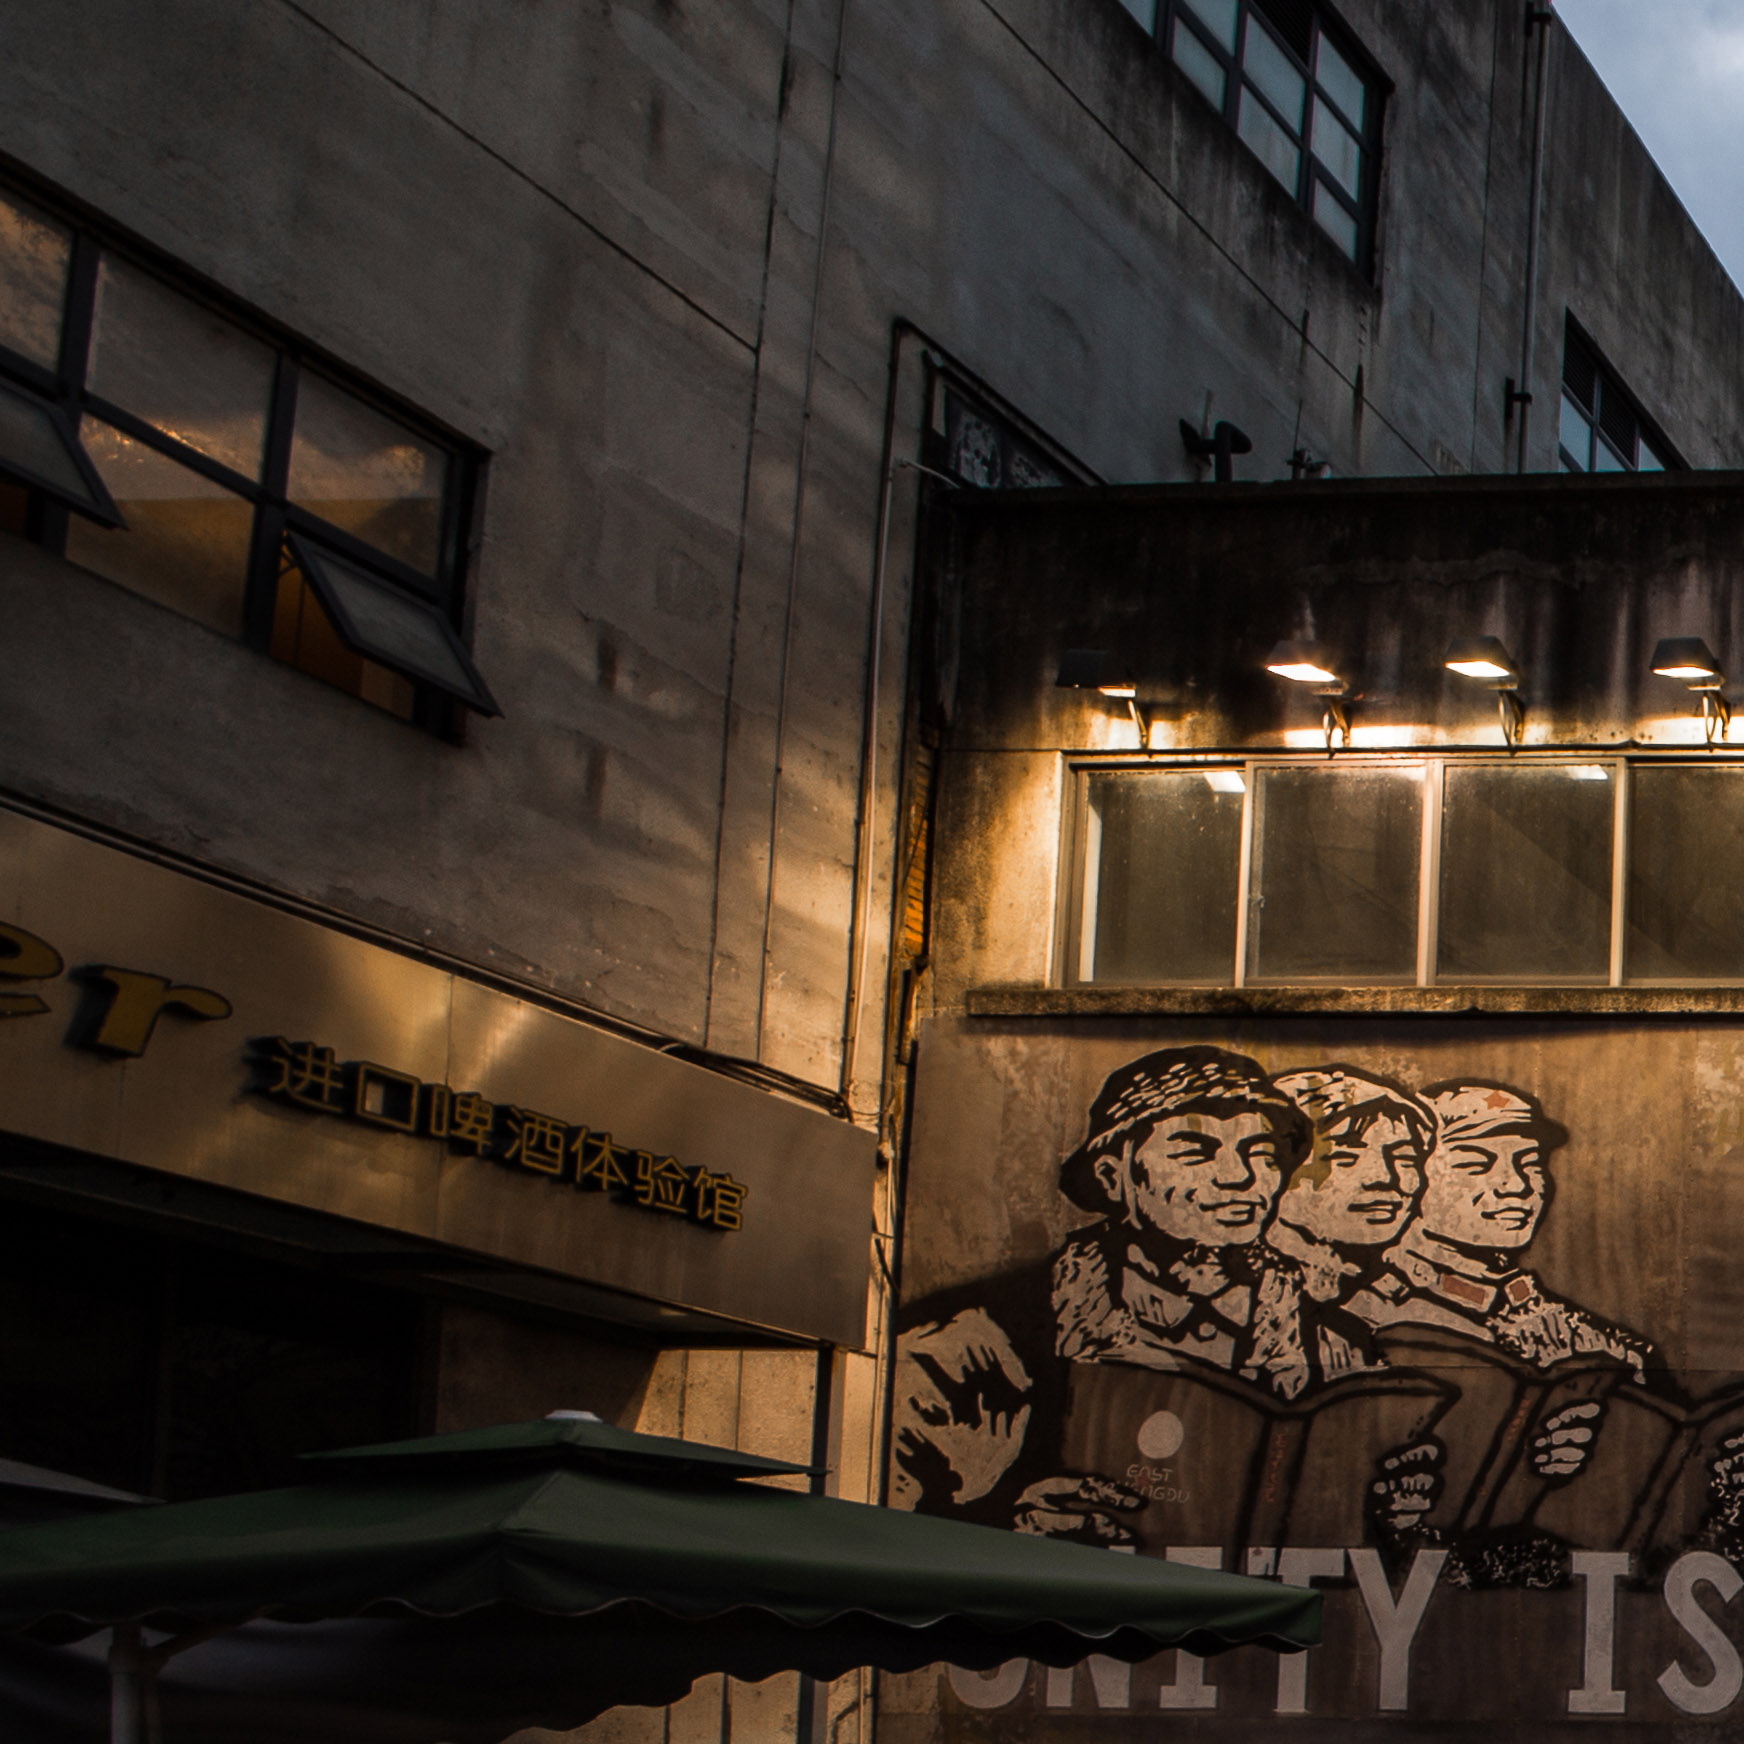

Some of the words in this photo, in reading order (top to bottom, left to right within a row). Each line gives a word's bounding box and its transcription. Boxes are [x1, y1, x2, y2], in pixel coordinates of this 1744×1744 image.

[266, 1036, 749, 1231] 进口啤酒体验馆
